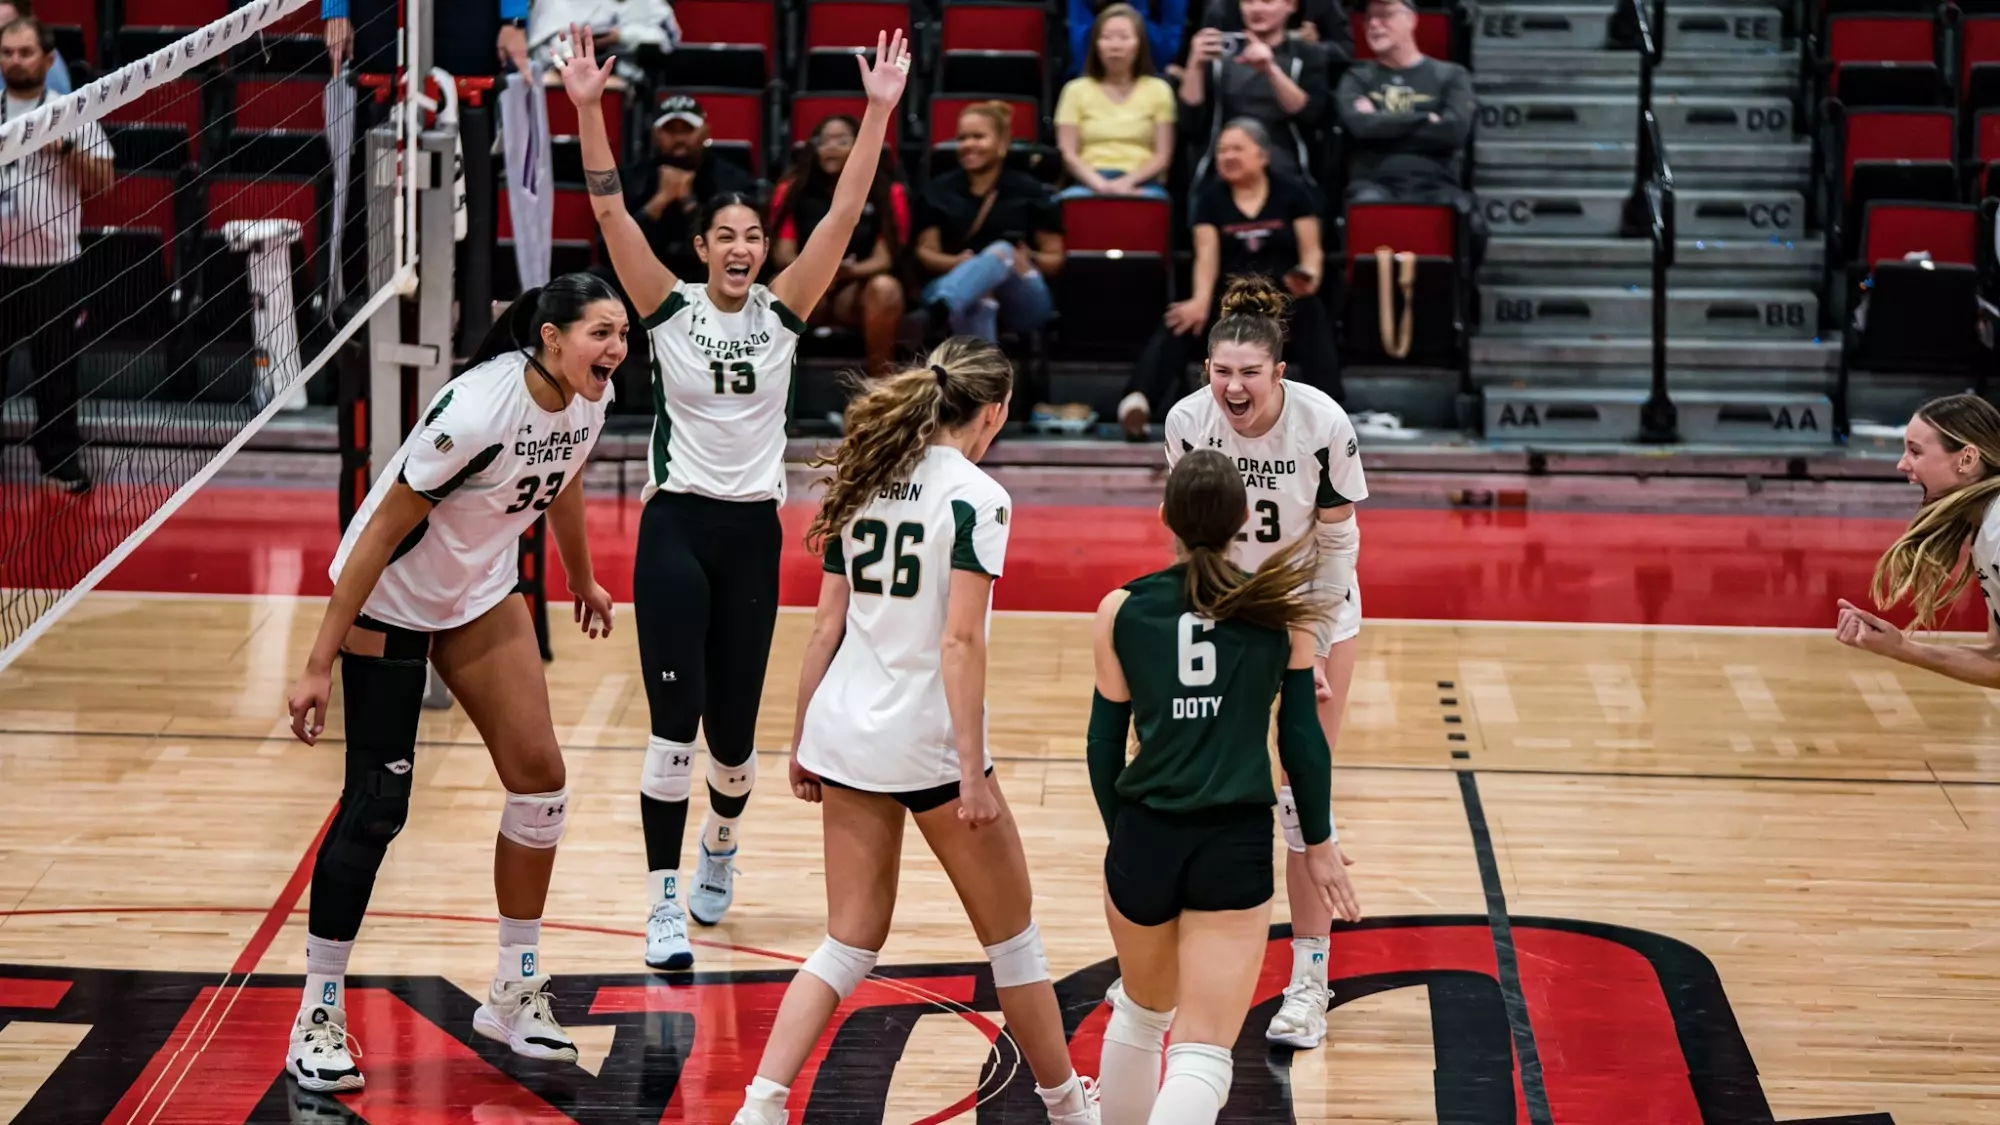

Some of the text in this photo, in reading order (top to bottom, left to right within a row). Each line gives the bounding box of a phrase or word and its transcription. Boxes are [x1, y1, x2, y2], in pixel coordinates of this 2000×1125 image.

[1482, 14, 1518, 38] EE
[1746, 107, 1785, 132] DD
[1485, 199, 1530, 225] CC
[1749, 203, 1791, 229] CC
[1765, 302, 1805, 327] BB
[708, 361, 757, 395] 13
[1498, 402, 1541, 428] AA
[1773, 405, 1818, 432] AA
[526, 446, 573, 466] STATE
[505, 470, 565, 515] 33
[851, 518, 925, 599] 26
[1178, 611, 1217, 687] 6
[1172, 696, 1223, 719] DOTY
